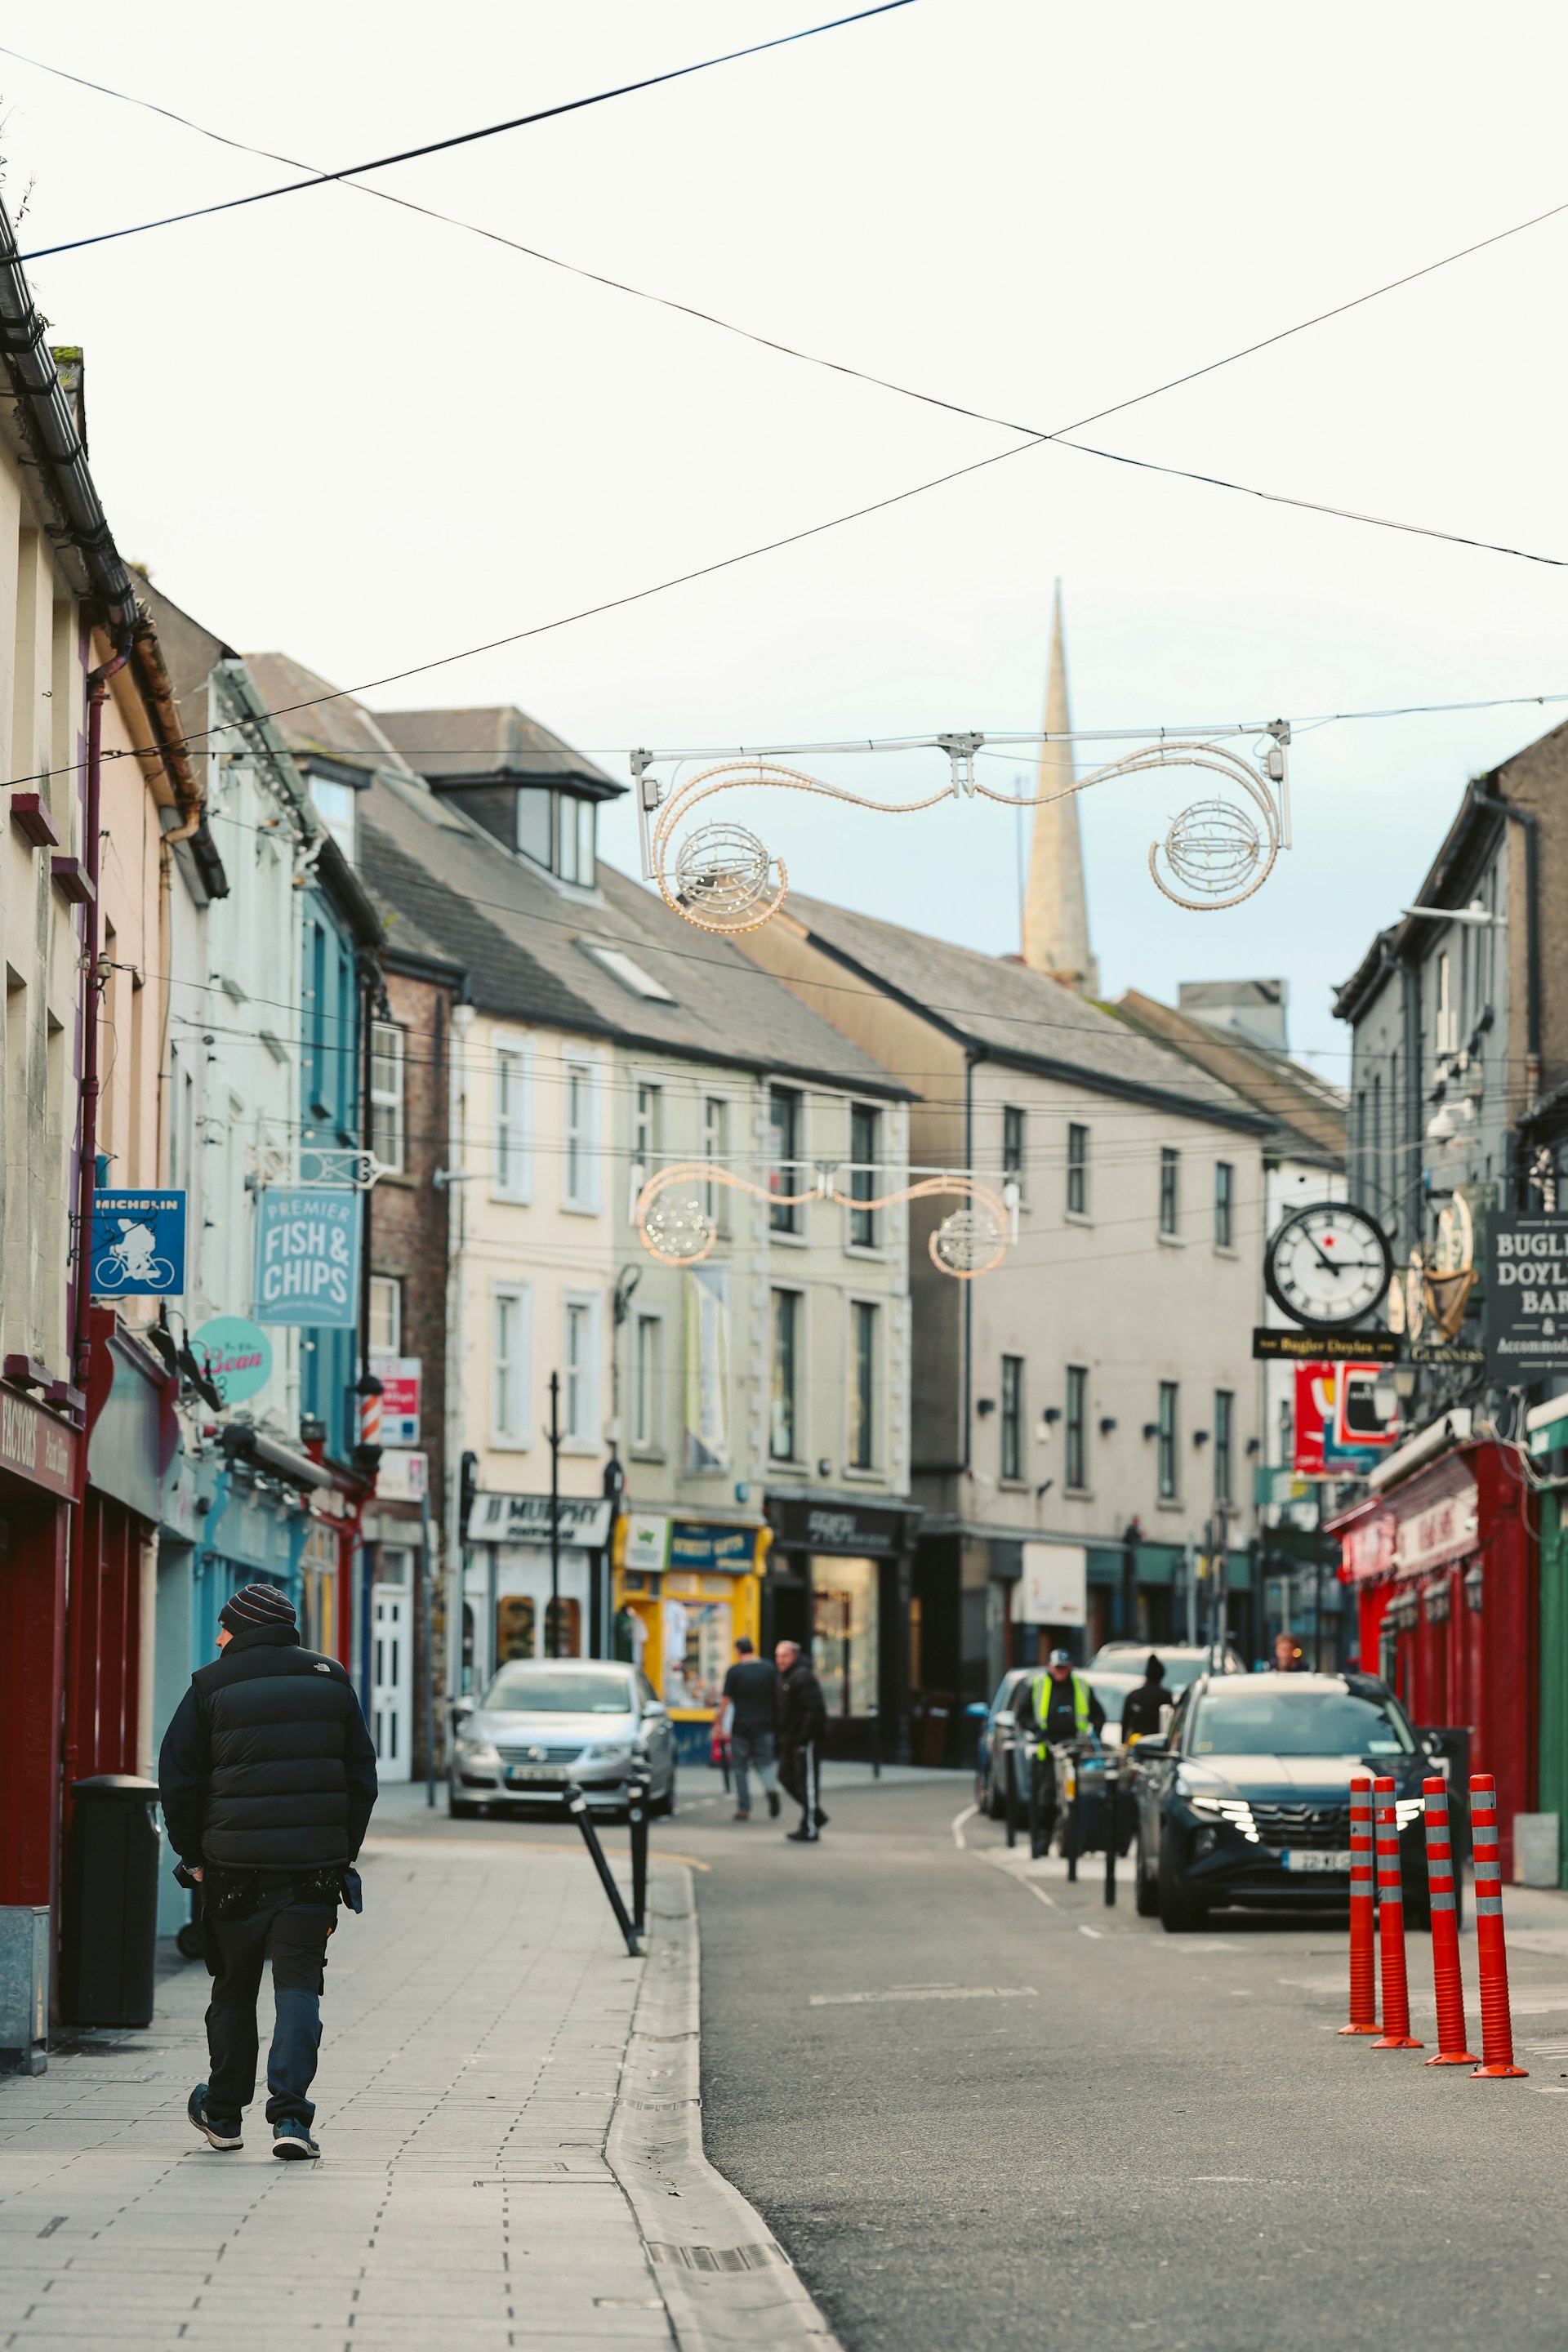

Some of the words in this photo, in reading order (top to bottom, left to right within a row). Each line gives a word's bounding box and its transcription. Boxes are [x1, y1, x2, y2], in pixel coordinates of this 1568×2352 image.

[95, 1199, 178, 1210] MICHELIN
[266, 1199, 351, 1223] PREMIER
[265, 1220, 326, 1264] FISH
[329, 1226, 350, 1267] &
[262, 1258, 349, 1304] CHIPS
[1496, 1261, 1568, 1286] DOYL
[1541, 1316, 1556, 1337] &
[1281, 1336, 1325, 1356] Bugler
[201, 1347, 262, 1375] Bean
[2, 1393, 38, 1471] FACTORS
